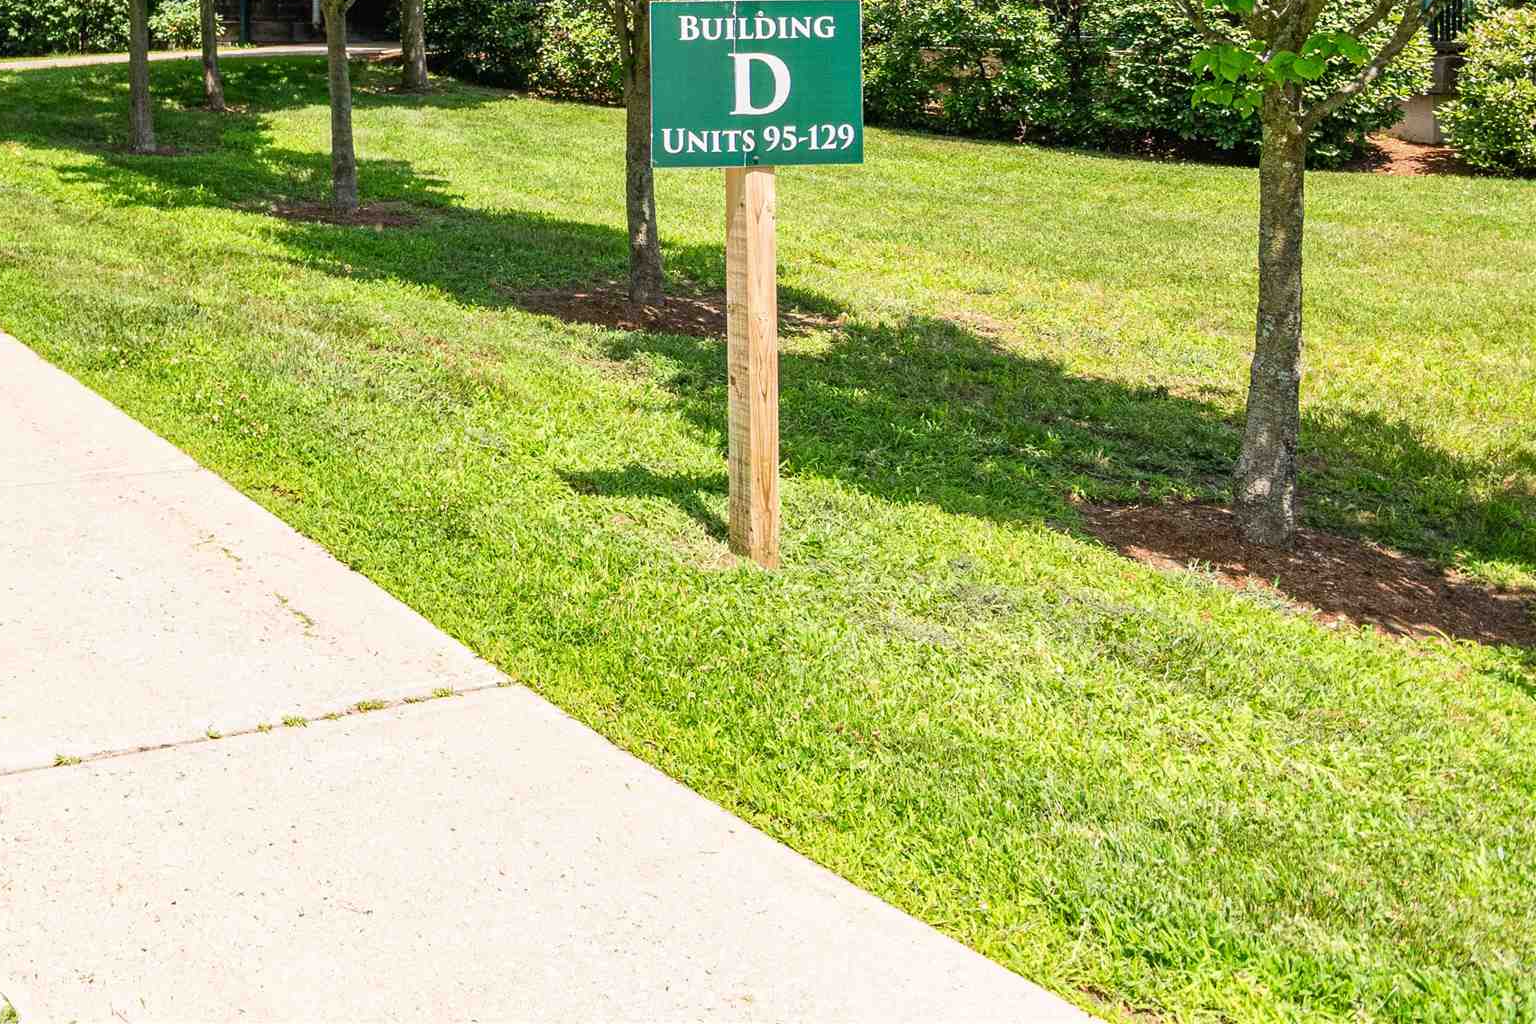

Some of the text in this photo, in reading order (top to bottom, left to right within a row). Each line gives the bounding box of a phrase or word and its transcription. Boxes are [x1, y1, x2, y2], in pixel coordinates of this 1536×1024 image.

[678, 14, 836, 41] BUILDING
[727, 52, 792, 116] D
[661, 123, 855, 154] UNITS 95-129
